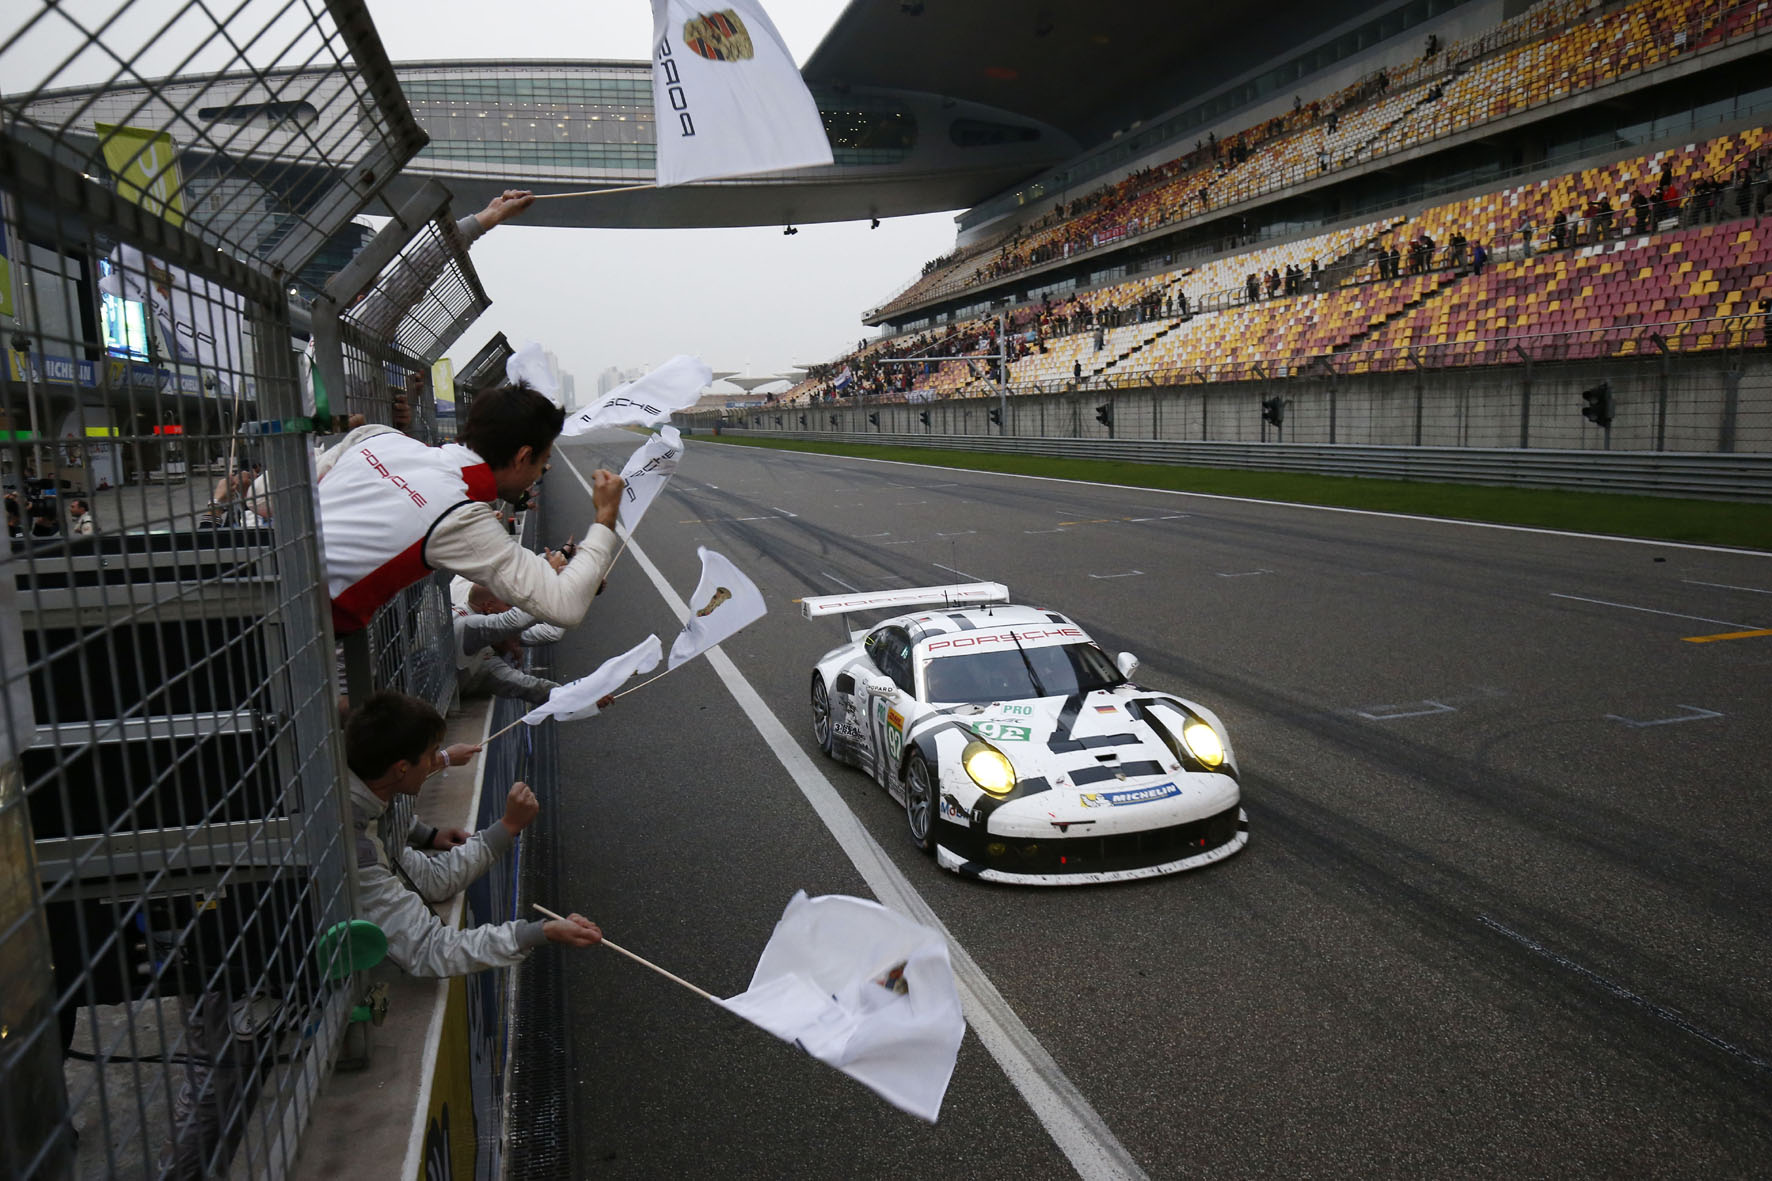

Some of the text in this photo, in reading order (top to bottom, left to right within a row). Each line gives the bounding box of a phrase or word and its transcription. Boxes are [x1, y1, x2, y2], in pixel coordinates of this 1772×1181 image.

[928, 628, 1083, 652] PORSCHE
[1003, 705, 1033, 715] PRO
[978, 722, 1026, 740] 92
[1112, 784, 1178, 803] MICHELIN
